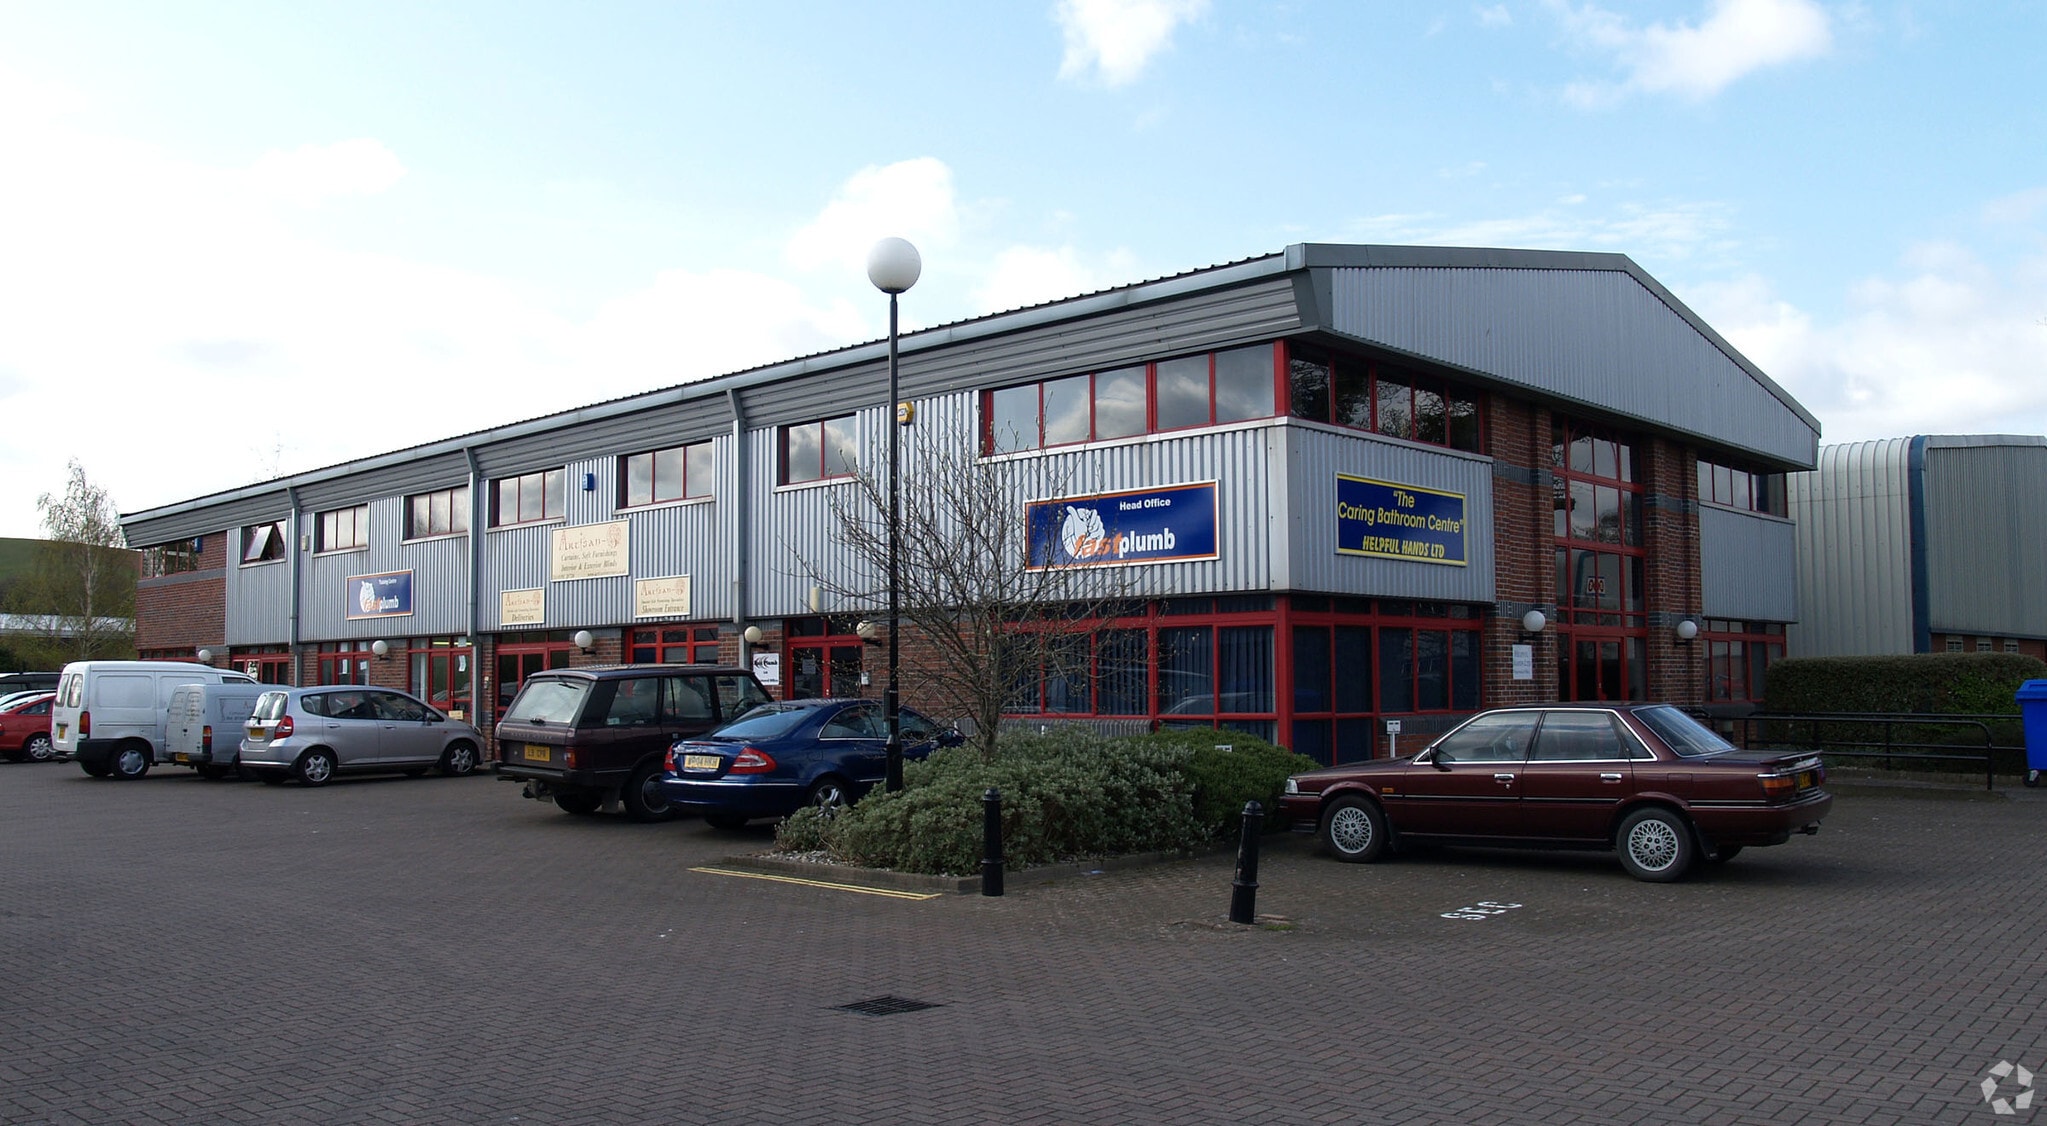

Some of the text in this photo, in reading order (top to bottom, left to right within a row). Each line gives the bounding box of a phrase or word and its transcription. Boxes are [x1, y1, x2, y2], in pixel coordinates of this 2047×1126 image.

[1120, 498, 1171, 511] Head Office
[1338, 501, 1375, 526] Caring
[1377, 507, 1426, 529] Bathroom
[1362, 535, 1445, 558] HELPFUL HANDS LTD
